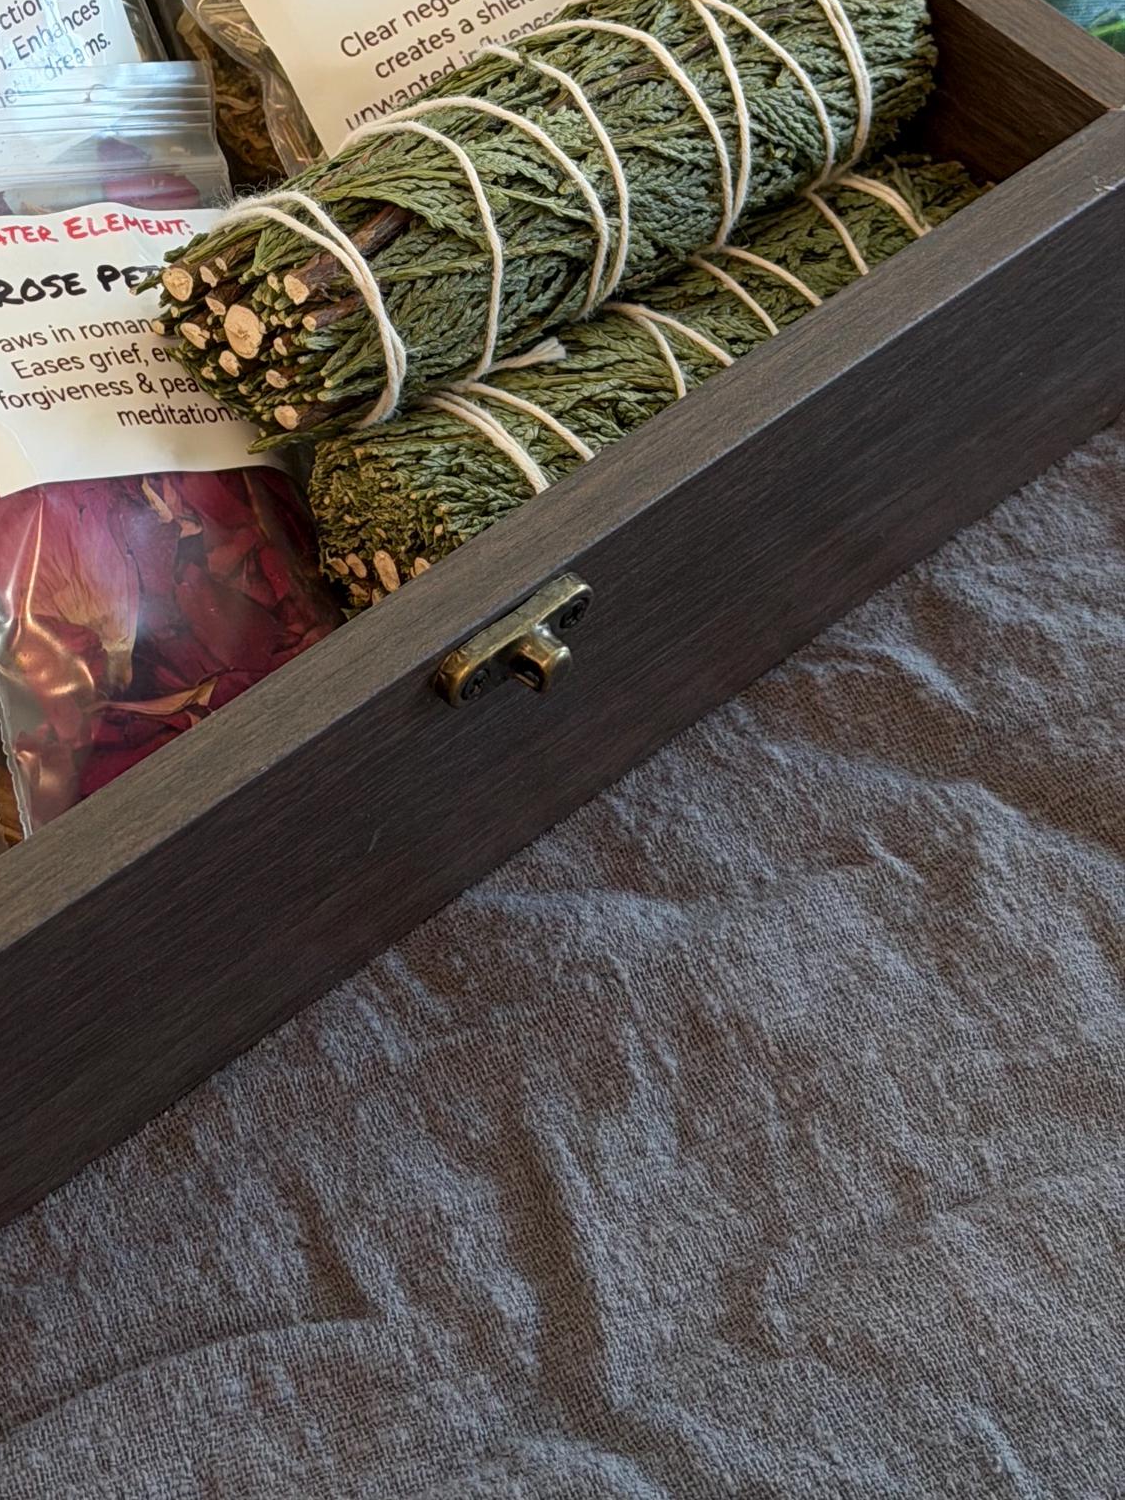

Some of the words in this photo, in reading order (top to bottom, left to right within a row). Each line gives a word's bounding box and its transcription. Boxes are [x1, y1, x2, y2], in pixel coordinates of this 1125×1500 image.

[339, 19, 400, 59] Clear
[374, 27, 456, 80] creates
[458, 17, 475, 35] a
[43, 34, 111, 82] dreams.
[63, 212, 195, 240] ELEMENT:
[96, 264, 163, 293] PET
[51, 323, 75, 345] in
[79, 317, 155, 340] roman
[10, 353, 86, 380] Eases
[89, 342, 150, 373] grief,
[136, 372, 158, 395] &
[159, 376, 207, 400] pea
